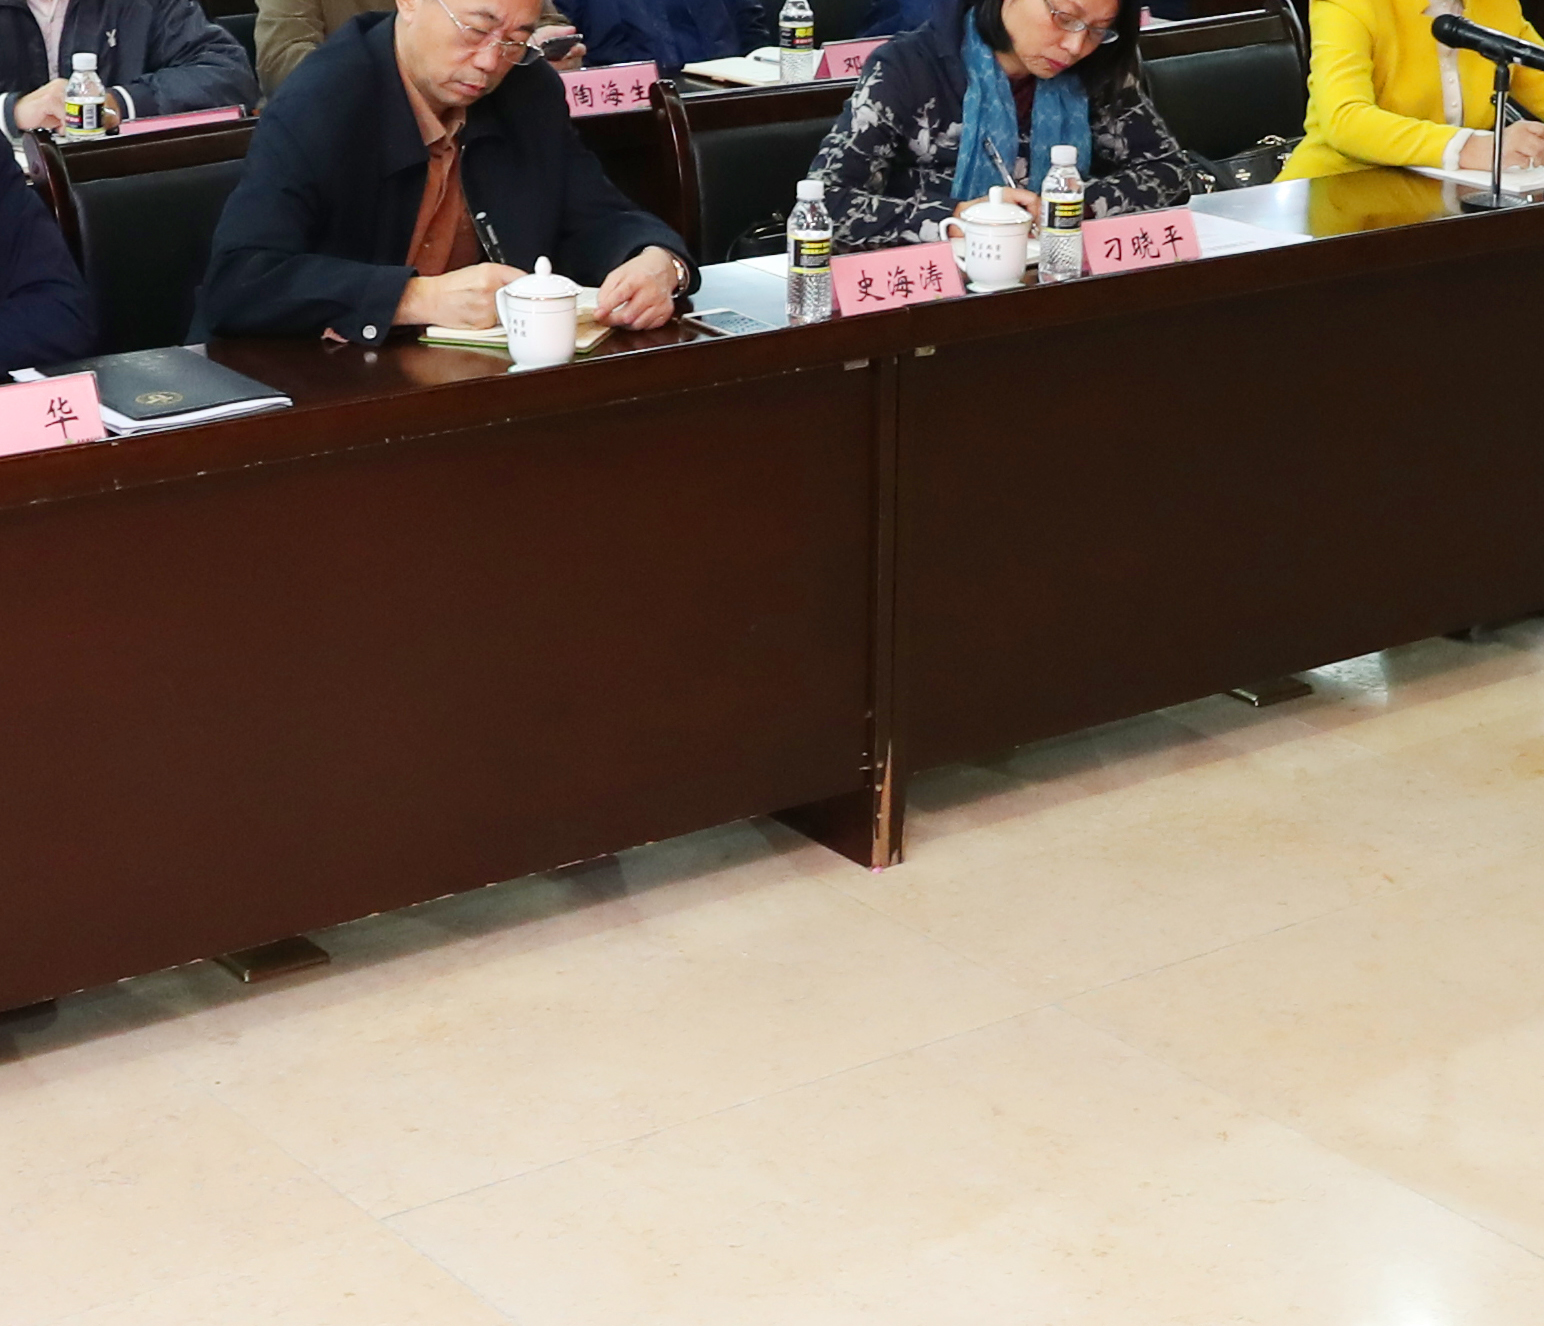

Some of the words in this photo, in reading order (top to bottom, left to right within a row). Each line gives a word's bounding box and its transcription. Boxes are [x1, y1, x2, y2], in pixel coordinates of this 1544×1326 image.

[571, 79, 650, 108] 陶海生
[1104, 224, 1184, 262] 刁晓平
[856, 260, 943, 302] 史海涛
